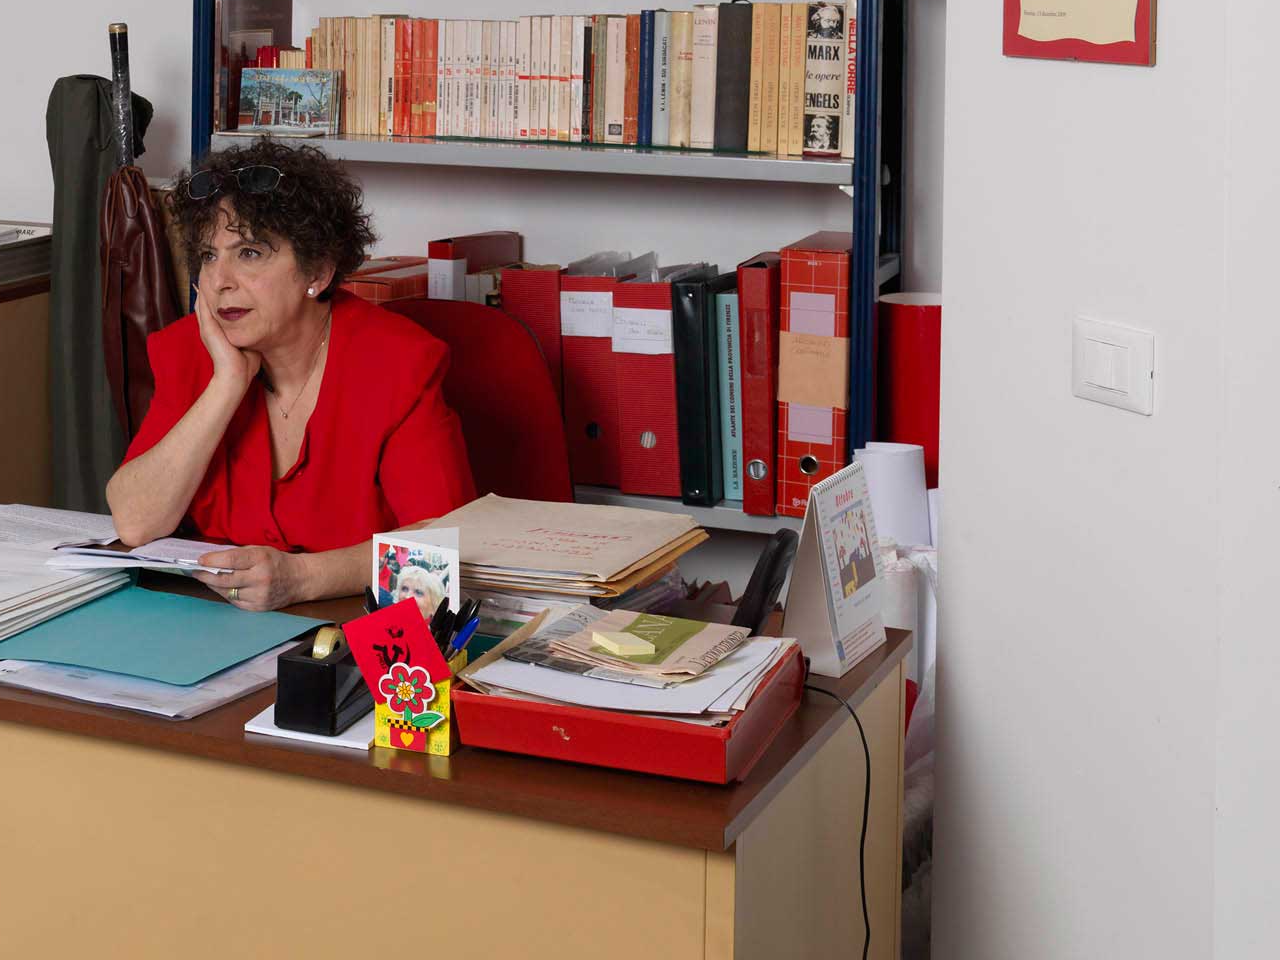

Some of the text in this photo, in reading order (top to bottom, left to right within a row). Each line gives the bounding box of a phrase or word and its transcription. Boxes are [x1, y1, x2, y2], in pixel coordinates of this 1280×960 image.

[848, 18, 856, 54] NELLA
[808, 45, 840, 61] MARX
[815, 72, 840, 81] opere
[847, 56, 856, 95] TORRE
[805, 93, 840, 109] ENGELS
